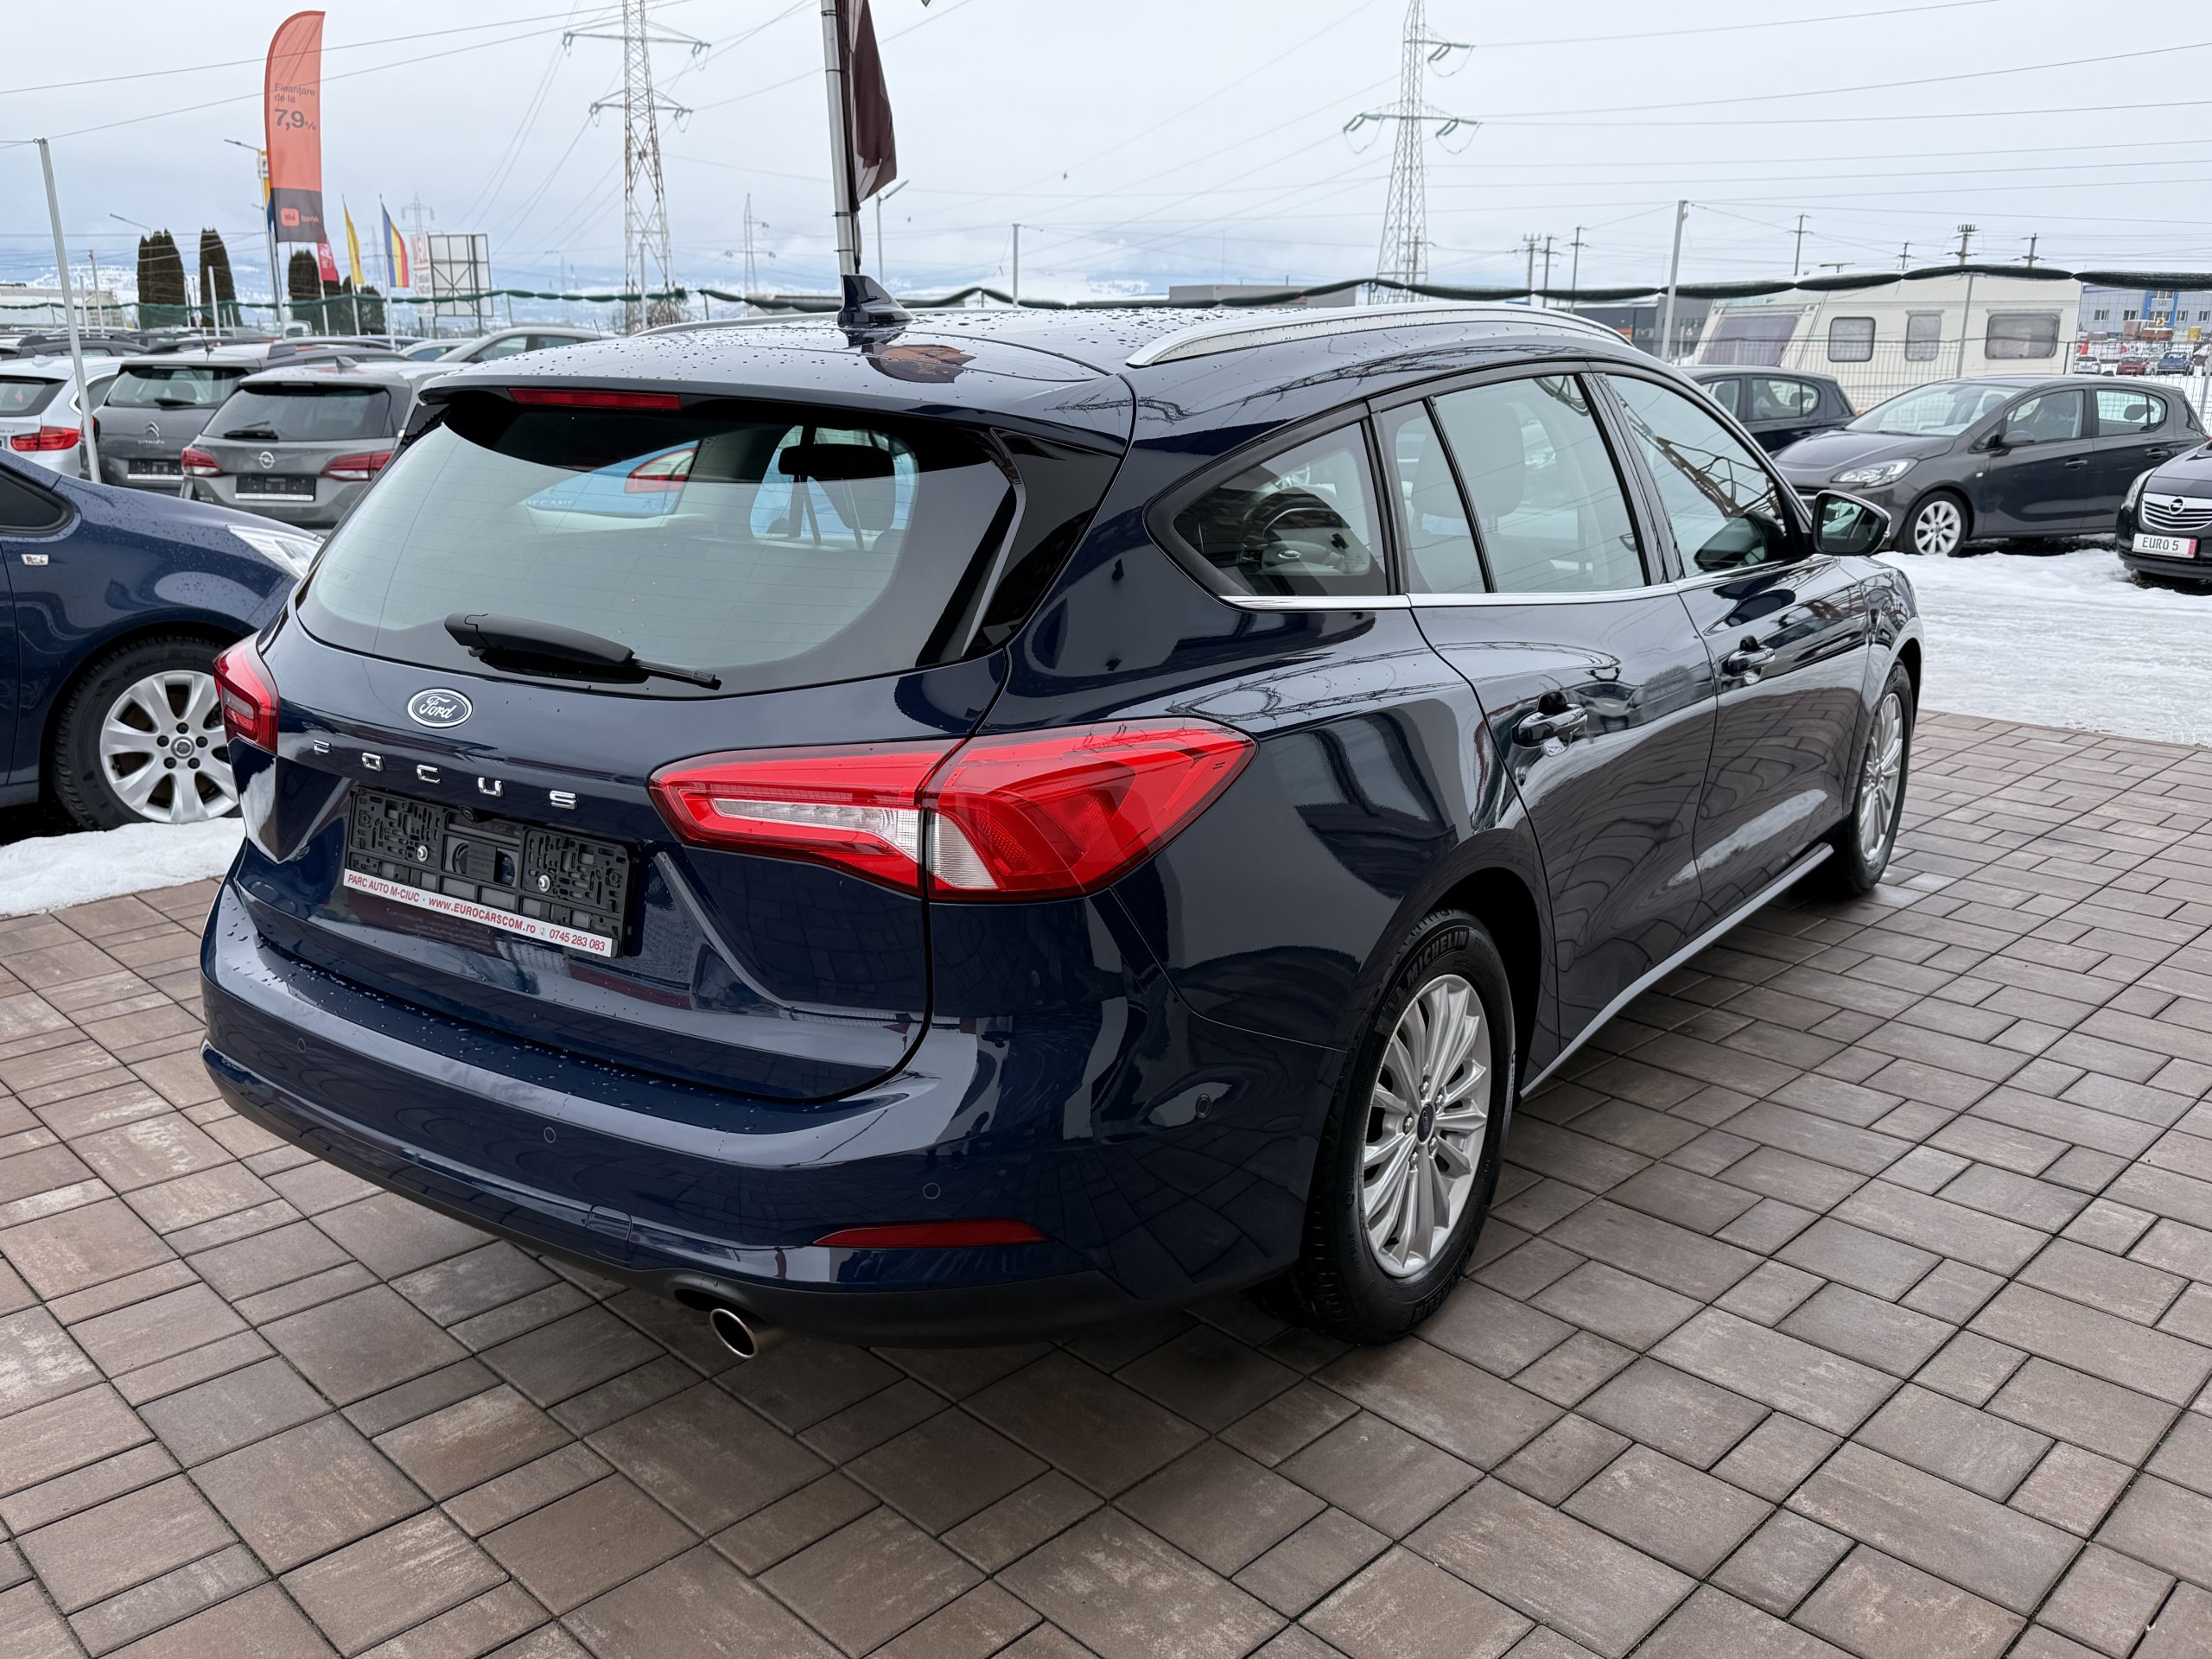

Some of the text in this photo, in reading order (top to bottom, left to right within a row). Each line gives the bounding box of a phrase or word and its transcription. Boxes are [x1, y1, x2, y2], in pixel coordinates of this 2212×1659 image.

[274, 93, 296, 104] de la
[2142, 537, 2180, 551] EURO 5
[419, 696, 458, 719] Ford
[313, 739, 578, 810] FOCUS
[347, 874, 368, 887] PARC
[368, 879, 390, 893] AUTO
[390, 886, 420, 903] M-CIUC
[549, 928, 570, 943] 0745
[571, 934, 588, 947] 283
[589, 938, 606, 951] 083
[1407, 931, 1468, 988] MICHELIN
